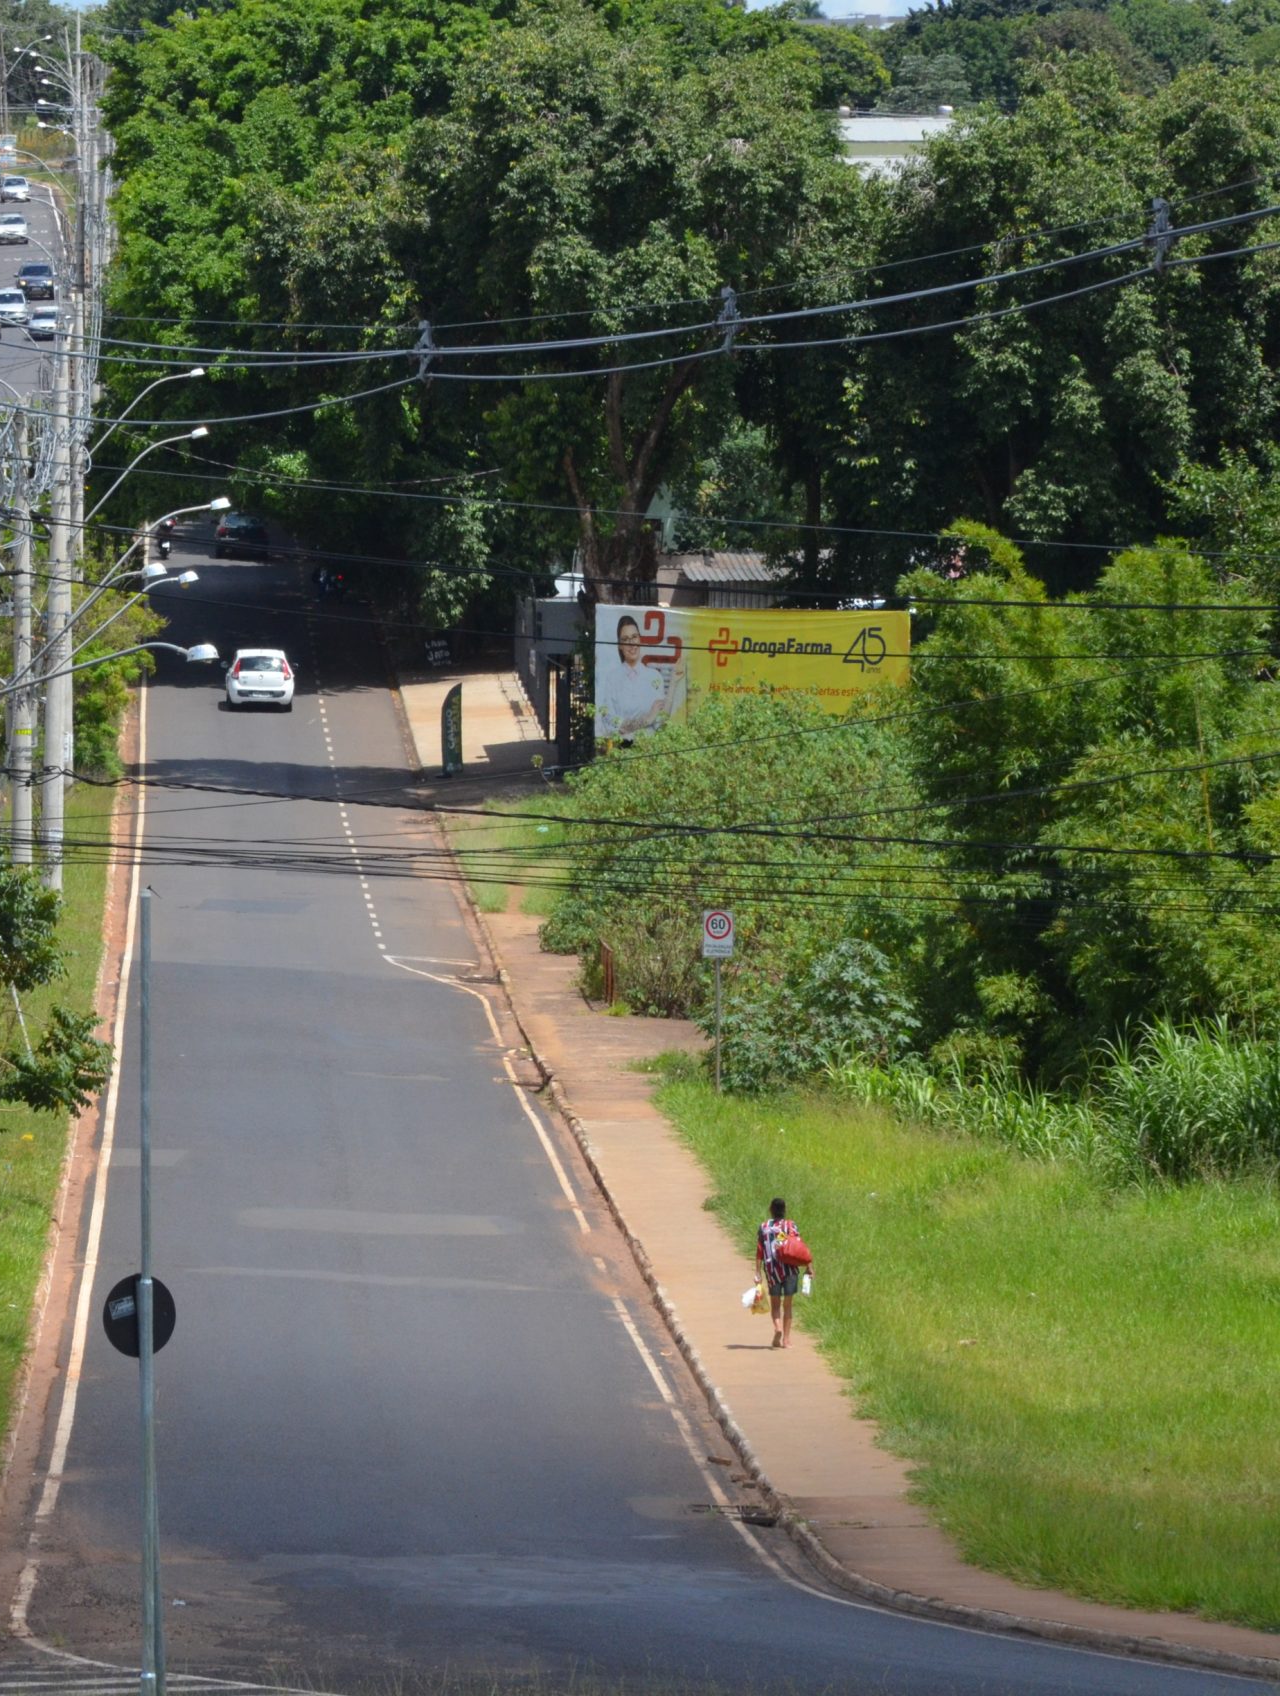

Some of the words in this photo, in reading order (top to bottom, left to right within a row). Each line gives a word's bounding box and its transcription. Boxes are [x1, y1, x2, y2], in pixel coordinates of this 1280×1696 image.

[741, 636, 833, 658] DrogaFarma
[446, 708, 455, 750] CALDO
[711, 918, 726, 930] 60
